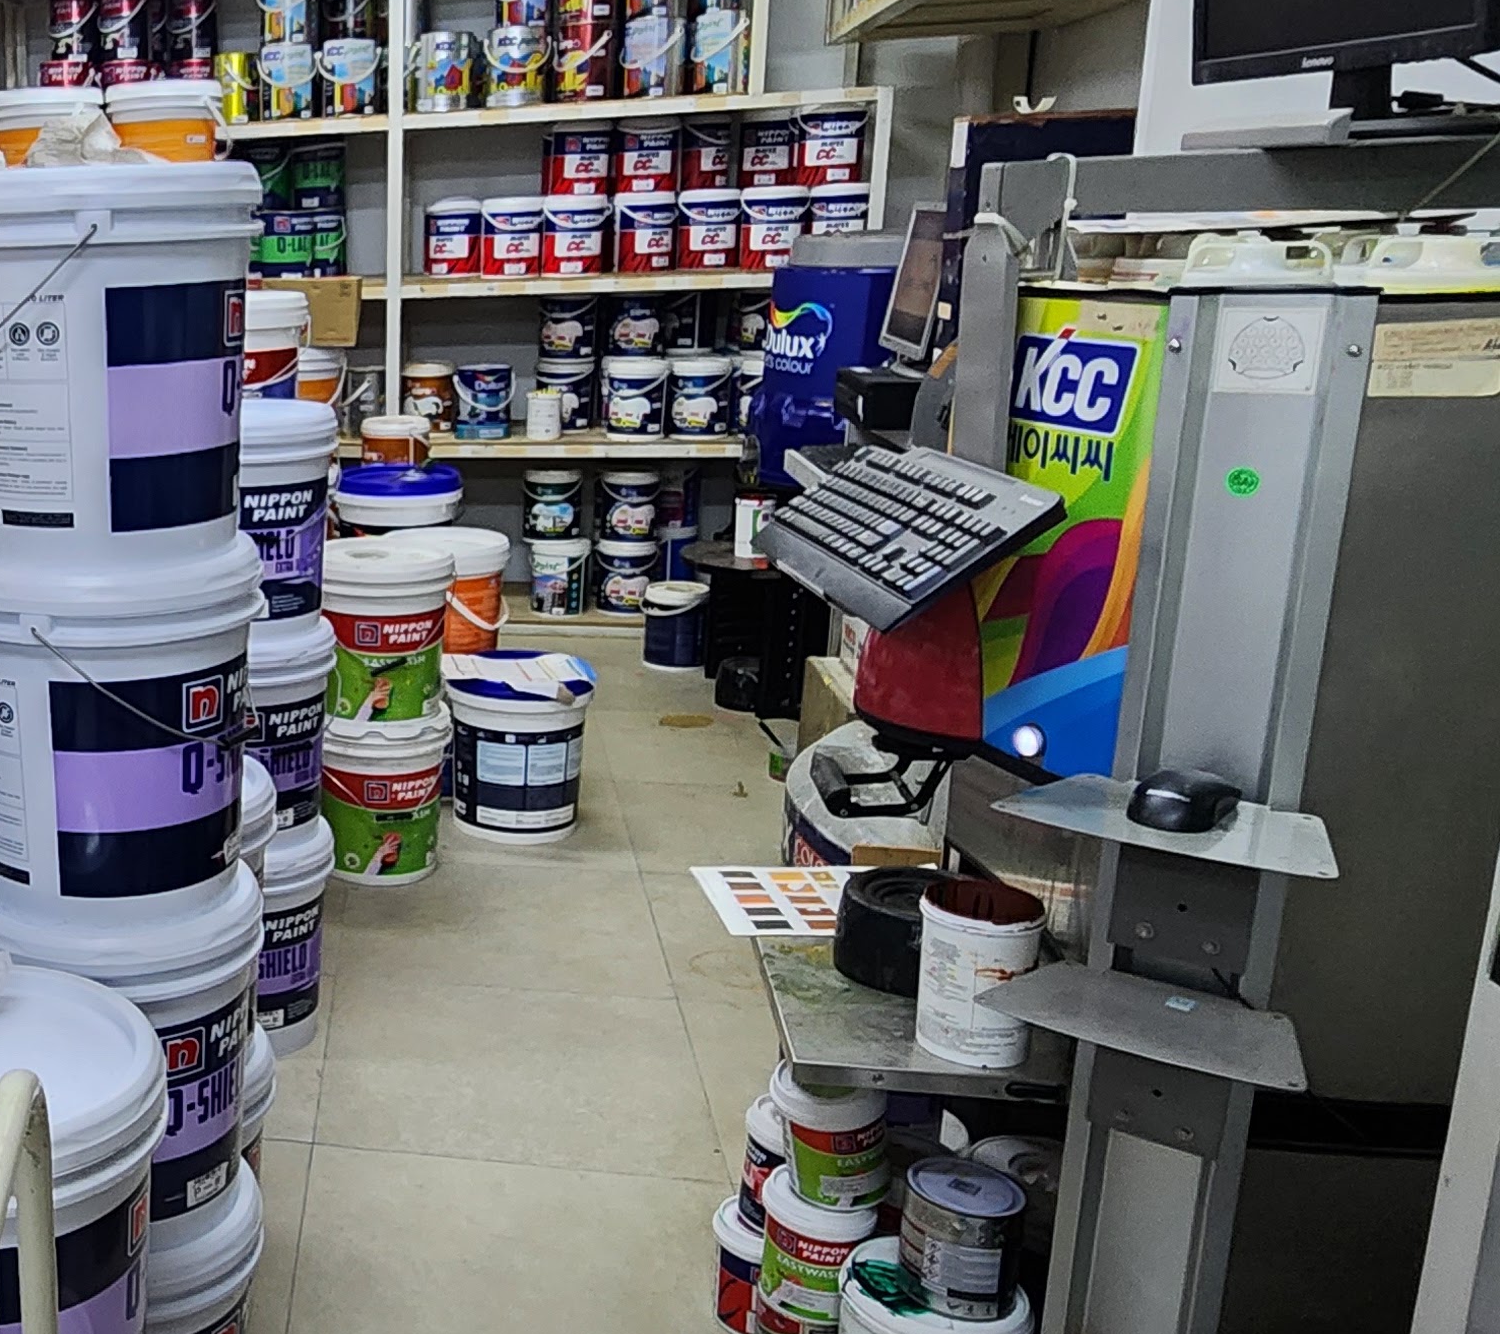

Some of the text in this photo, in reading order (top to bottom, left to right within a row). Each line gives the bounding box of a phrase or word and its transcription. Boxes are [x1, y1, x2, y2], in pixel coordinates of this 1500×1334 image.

[37, 293, 66, 303] LITER
[766, 323, 815, 359] Dulux
[775, 358, 814, 375] colour
[1014, 328, 1120, 423] KCC
[244, 488, 313, 510] NIPPON
[252, 504, 309, 523] PAINT
[382, 620, 433, 635] NIPPON
[388, 630, 429, 645] PAINT
[269, 702, 324, 726] NIPPON
[276, 717, 321, 738] PAINT
[265, 903, 320, 932] NIPPON
[271, 919, 316, 943] PAINT
[257, 942, 309, 980] SHIELD
[797, 1240, 850, 1256] NIPPON
[801, 1250, 844, 1264] PAINT
